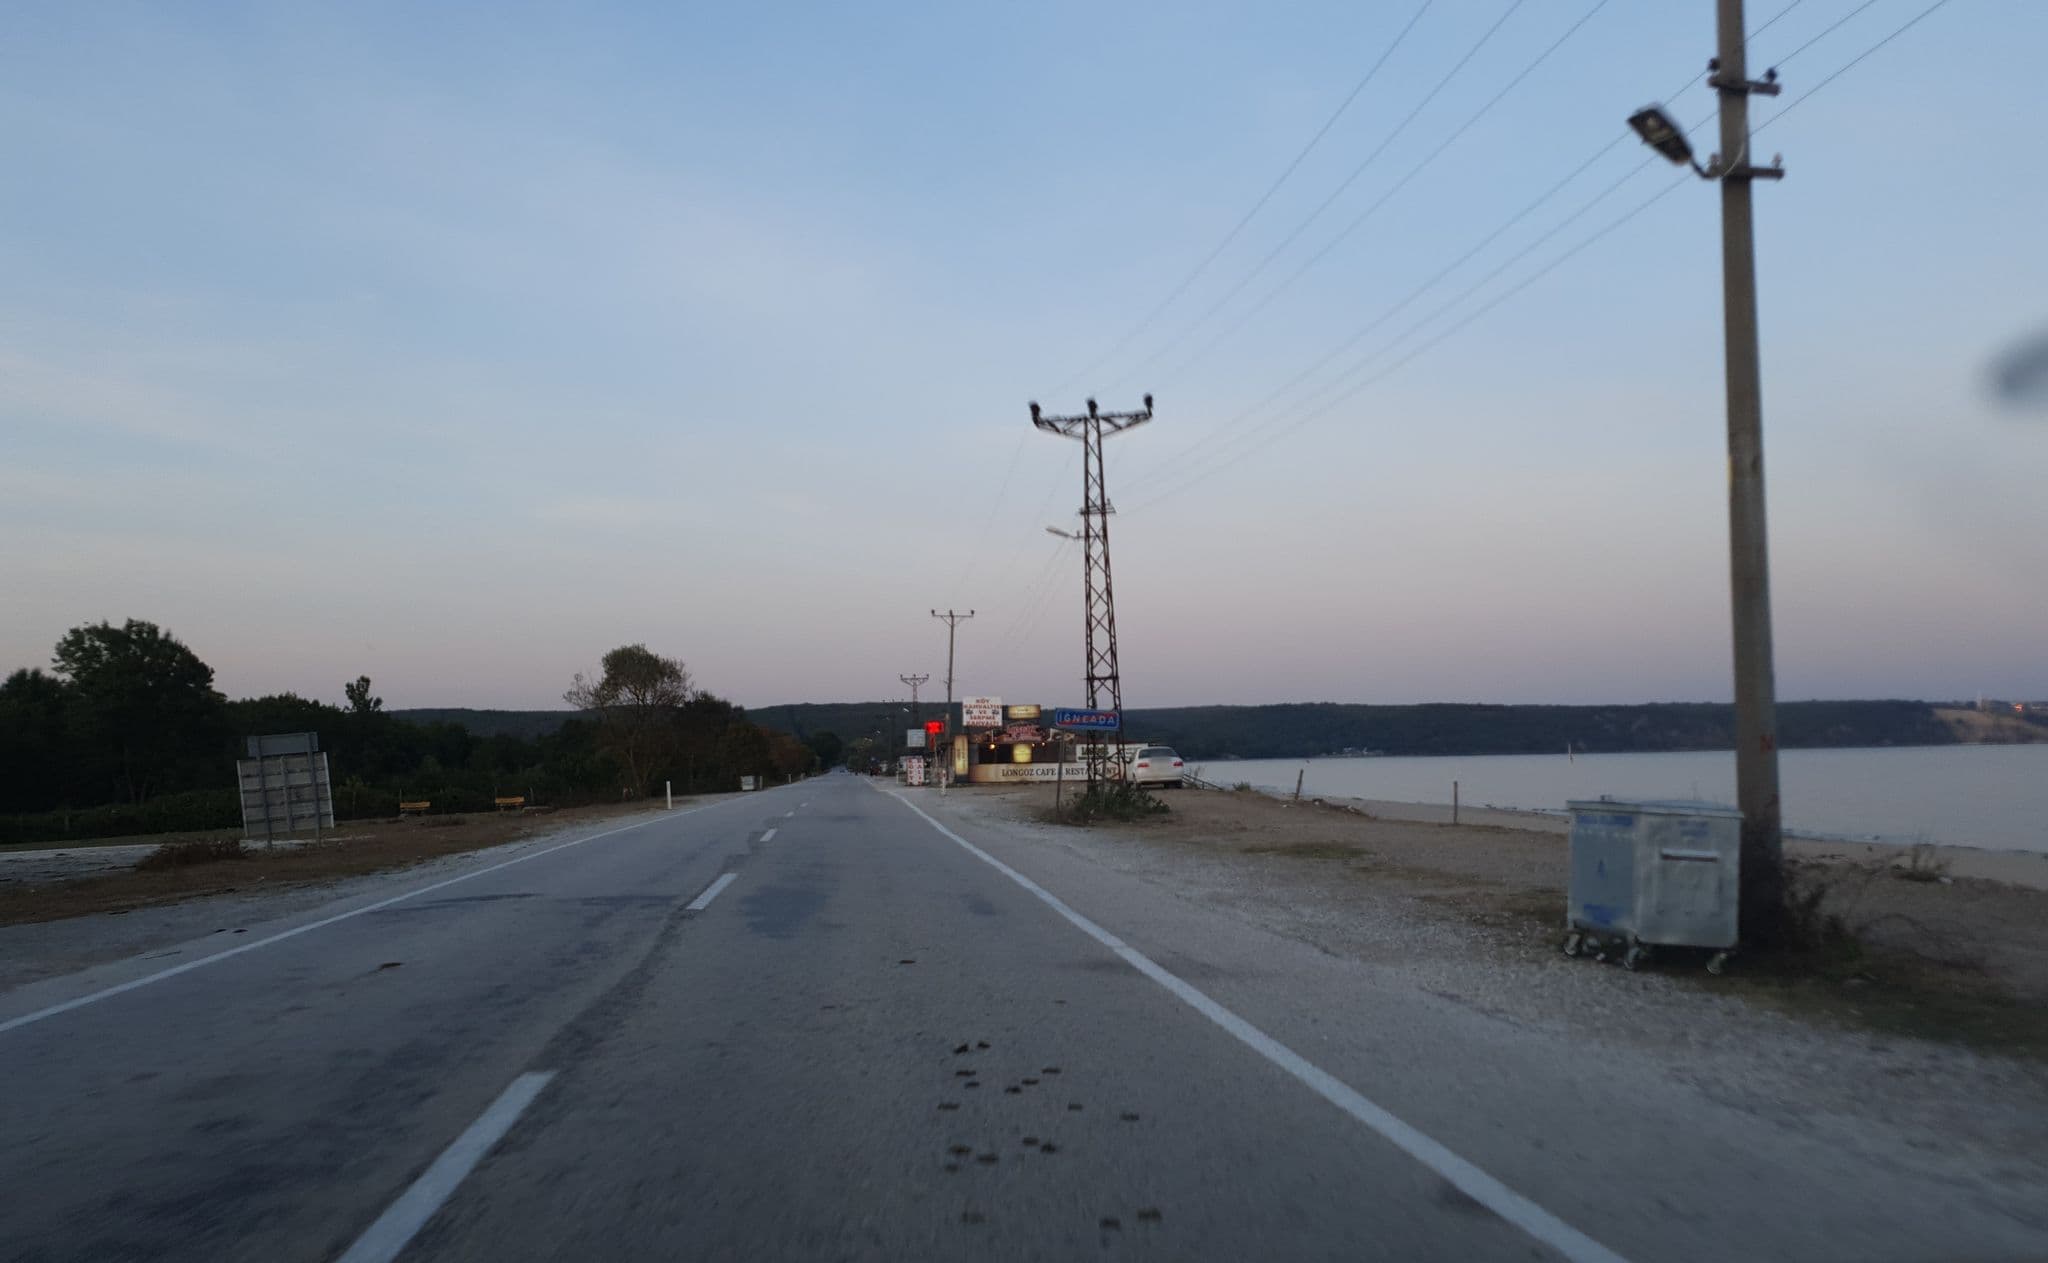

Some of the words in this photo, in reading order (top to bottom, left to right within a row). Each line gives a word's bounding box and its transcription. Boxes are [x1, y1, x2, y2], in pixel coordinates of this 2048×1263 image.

[1001, 768, 1034, 777] LONGOZ
[1036, 767, 1056, 776] CAFE
[1065, 767, 1117, 776] RESTARNT
